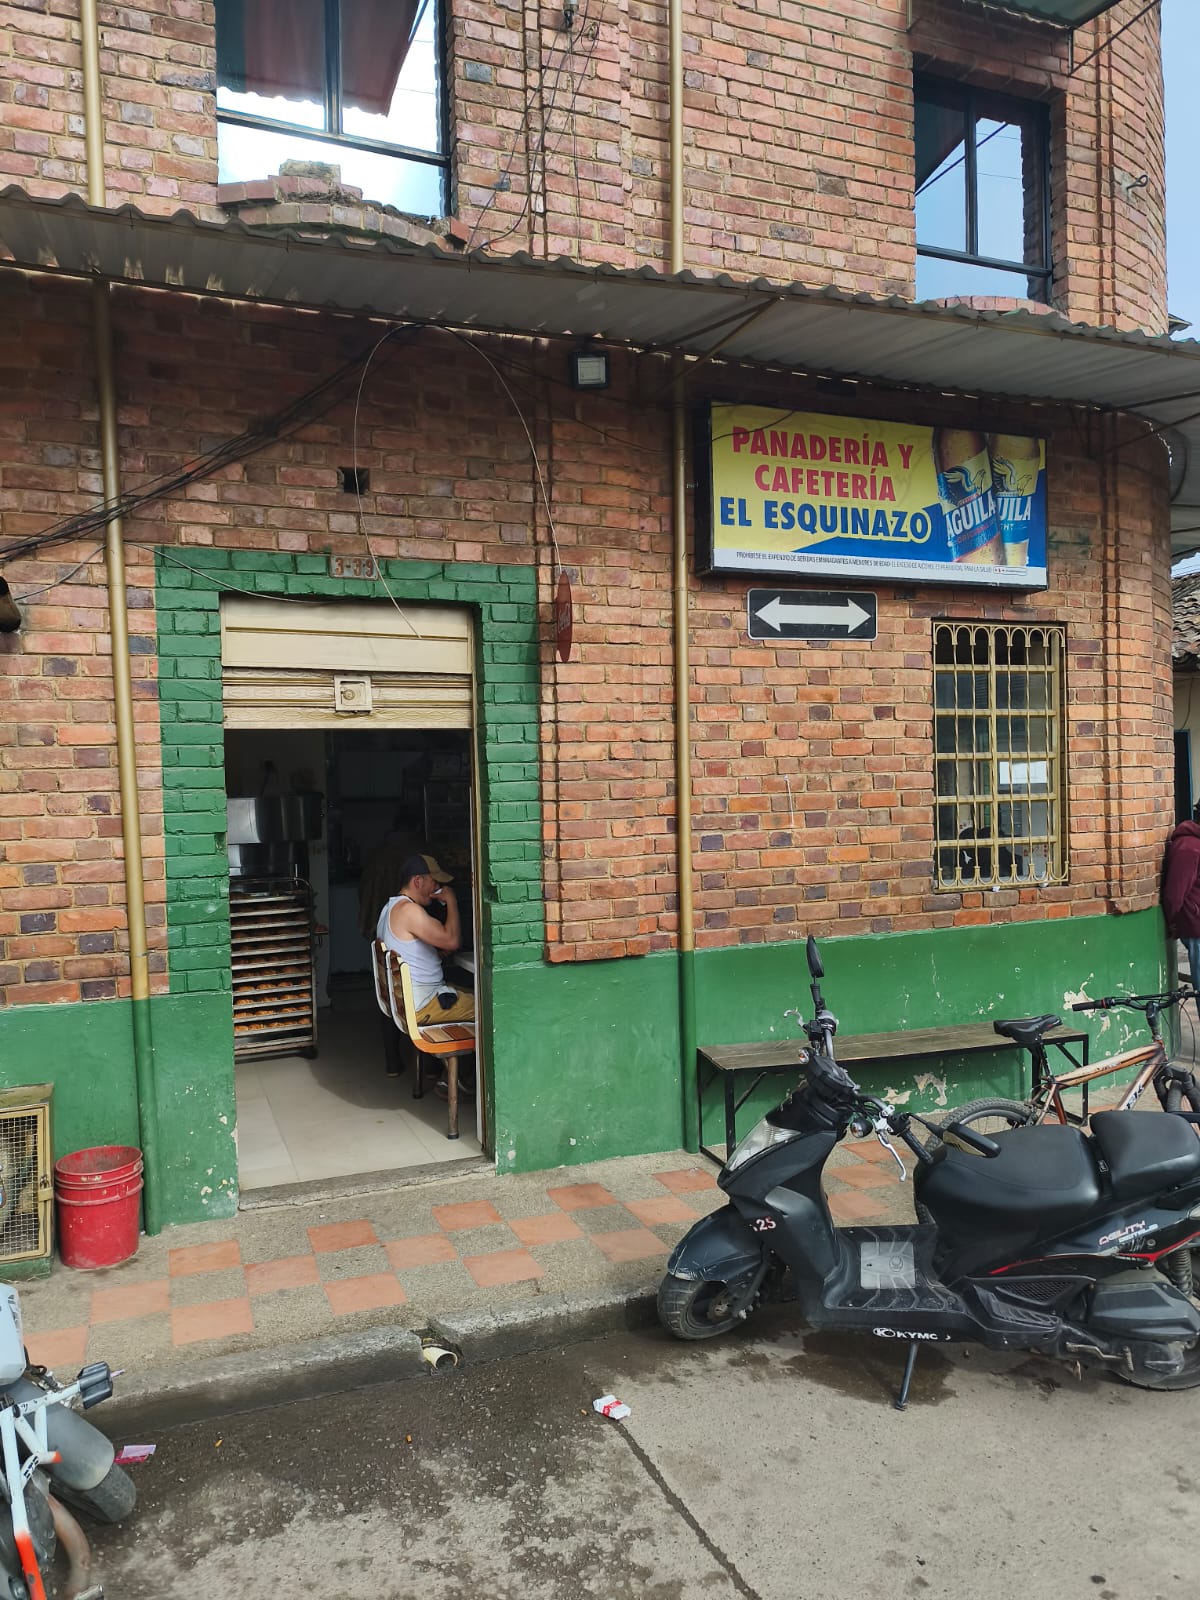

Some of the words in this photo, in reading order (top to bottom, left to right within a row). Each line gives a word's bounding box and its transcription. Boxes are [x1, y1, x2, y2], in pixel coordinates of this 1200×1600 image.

[732, 426, 888, 468] PANADERÍA
[897, 444, 914, 470] Y
[754, 463, 896, 502] CAFETERÍA
[720, 496, 752, 527] EL
[764, 500, 930, 540] ESQUINAZO
[997, 495, 1032, 521] UILA
